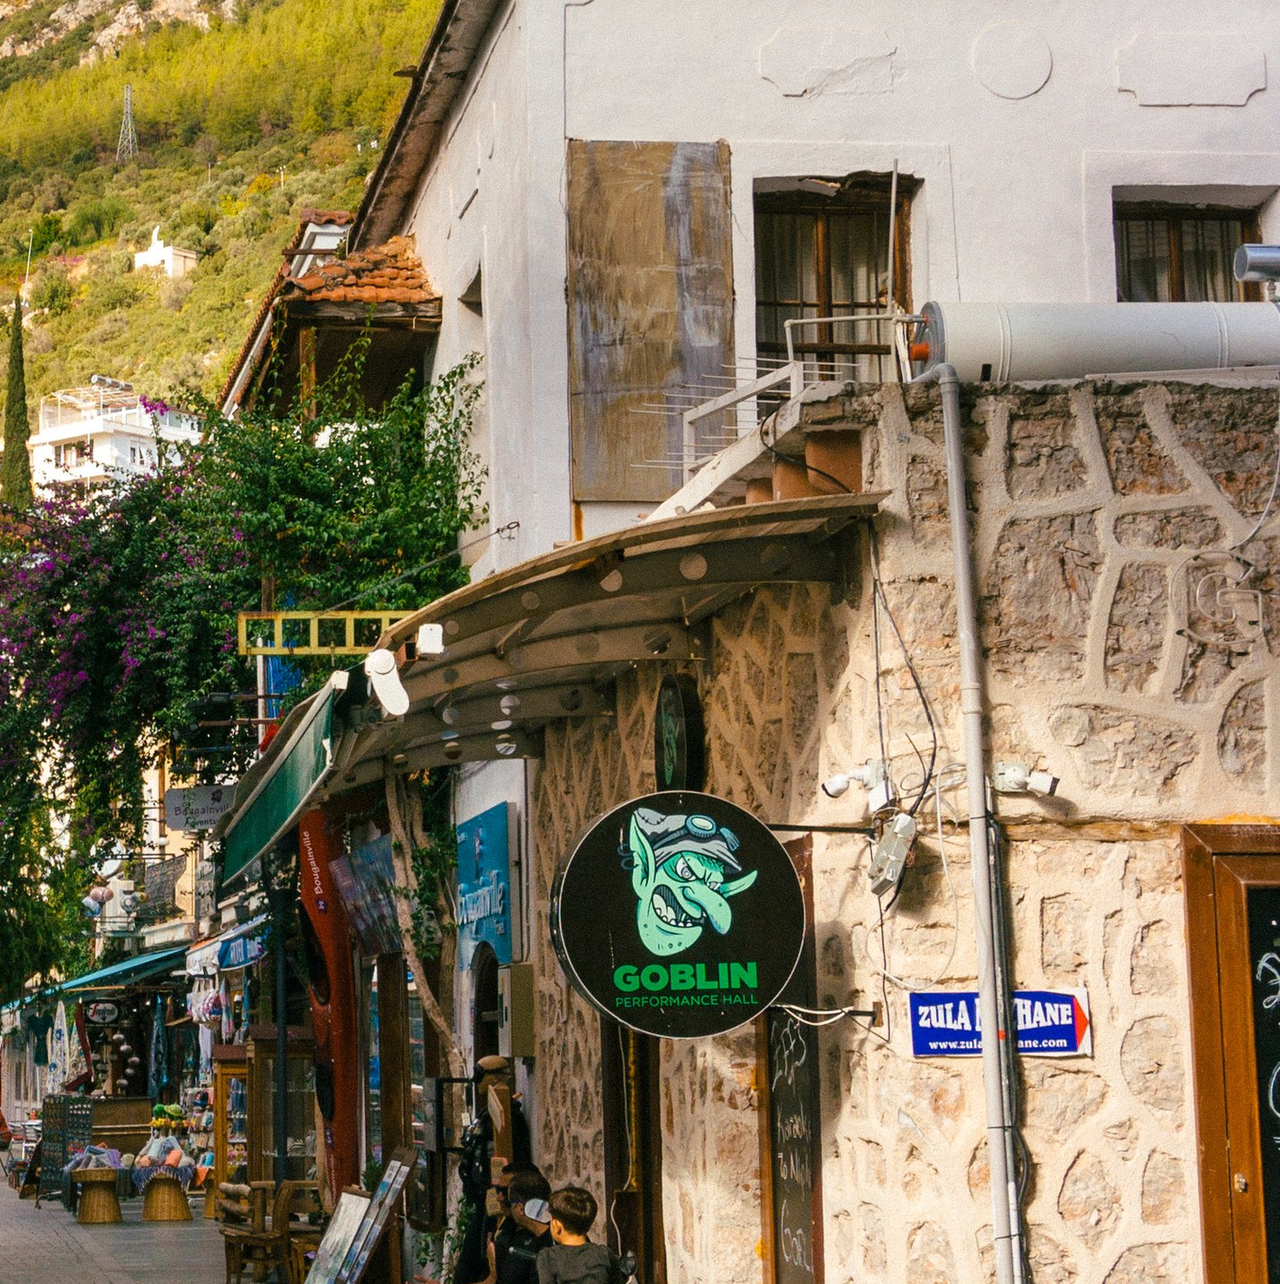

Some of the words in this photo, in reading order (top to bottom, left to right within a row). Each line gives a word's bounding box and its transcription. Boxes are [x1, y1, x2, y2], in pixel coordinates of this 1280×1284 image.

[303, 830, 324, 895] Bougainville
[613, 962, 758, 992] GOBLIN
[615, 994, 719, 1008] PERFORMANCE
[722, 994, 759, 1005] HALL
[918, 1000, 973, 1032] ZULA
[974, 998, 1073, 1032] HANE
